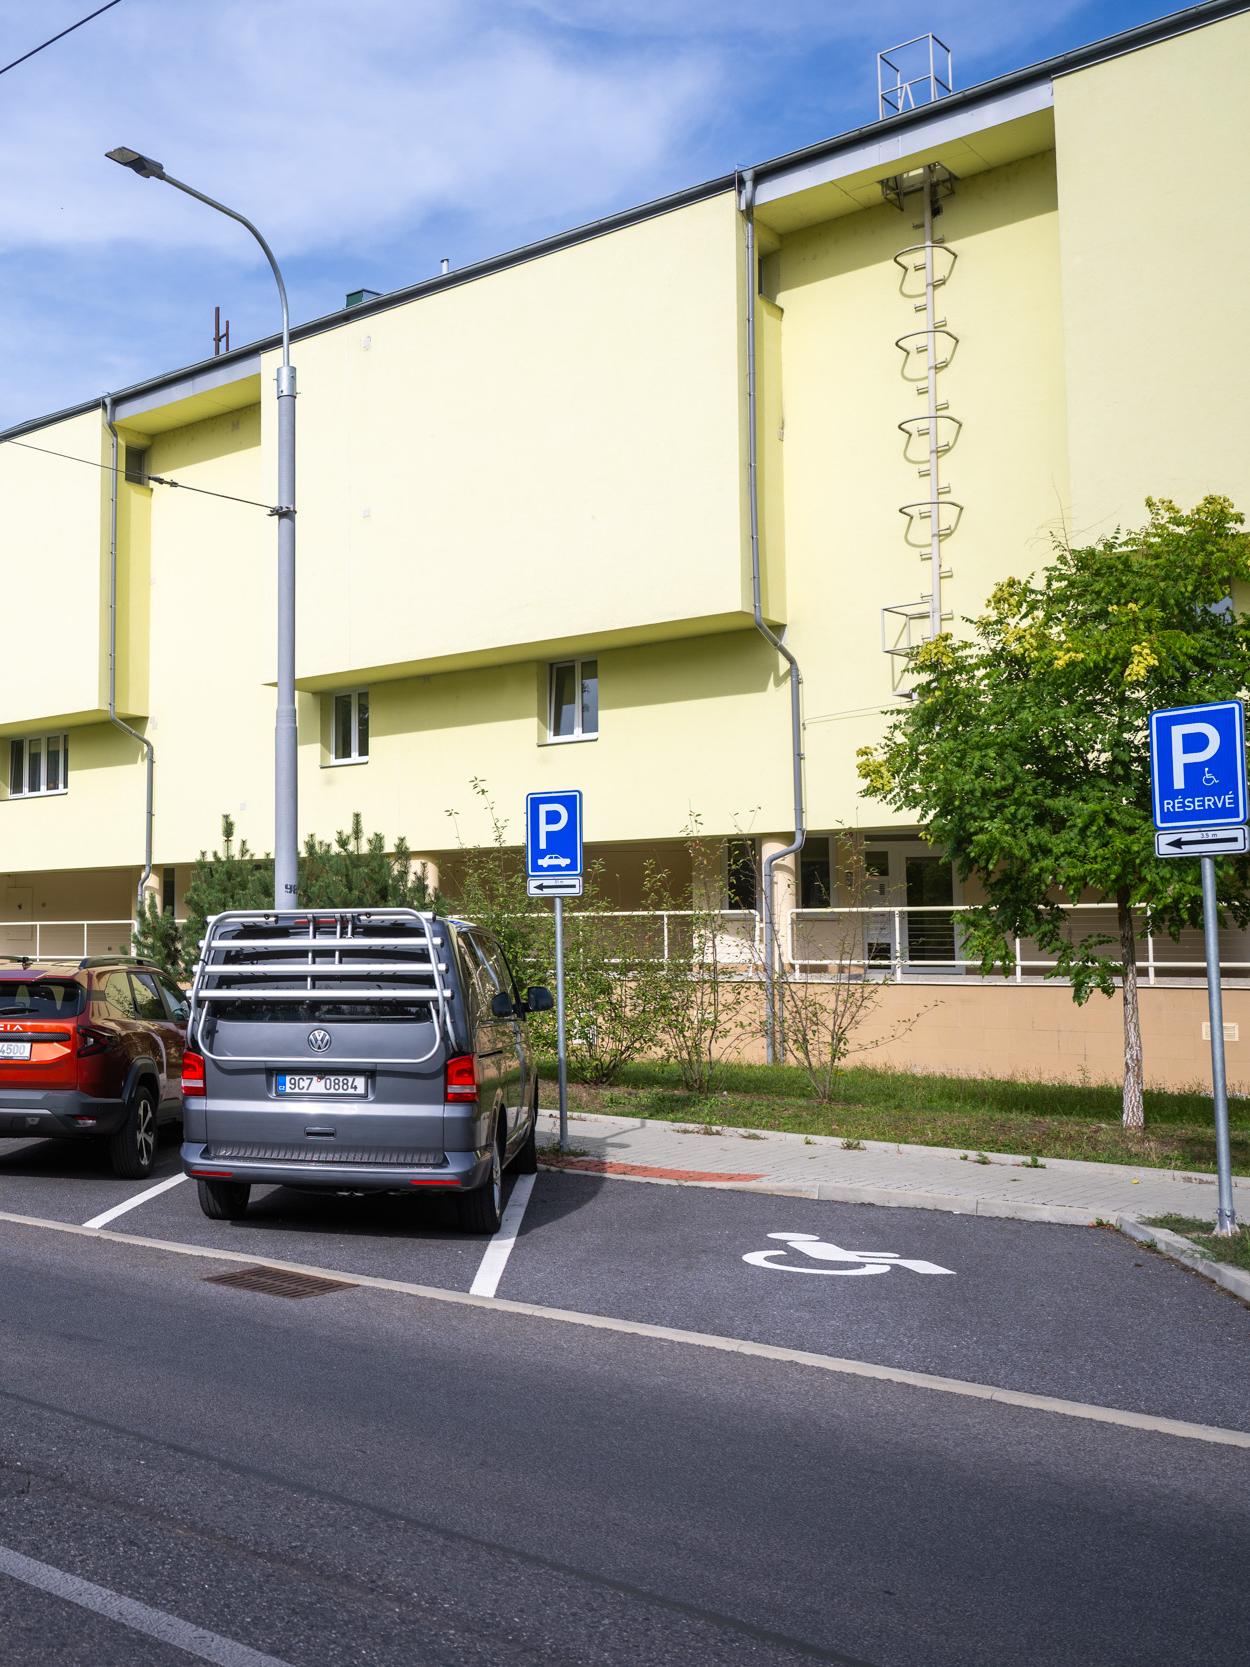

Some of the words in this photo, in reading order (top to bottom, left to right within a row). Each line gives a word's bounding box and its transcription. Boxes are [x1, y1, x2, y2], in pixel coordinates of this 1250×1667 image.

[1171, 722, 1221, 790] P
[1163, 791, 1235, 813] RÉSERVÉ
[539, 803, 569, 850] P
[0, 1044, 26, 1056] 4500
[288, 1077, 314, 1091] 9C7
[324, 1077, 358, 1092] 0884
